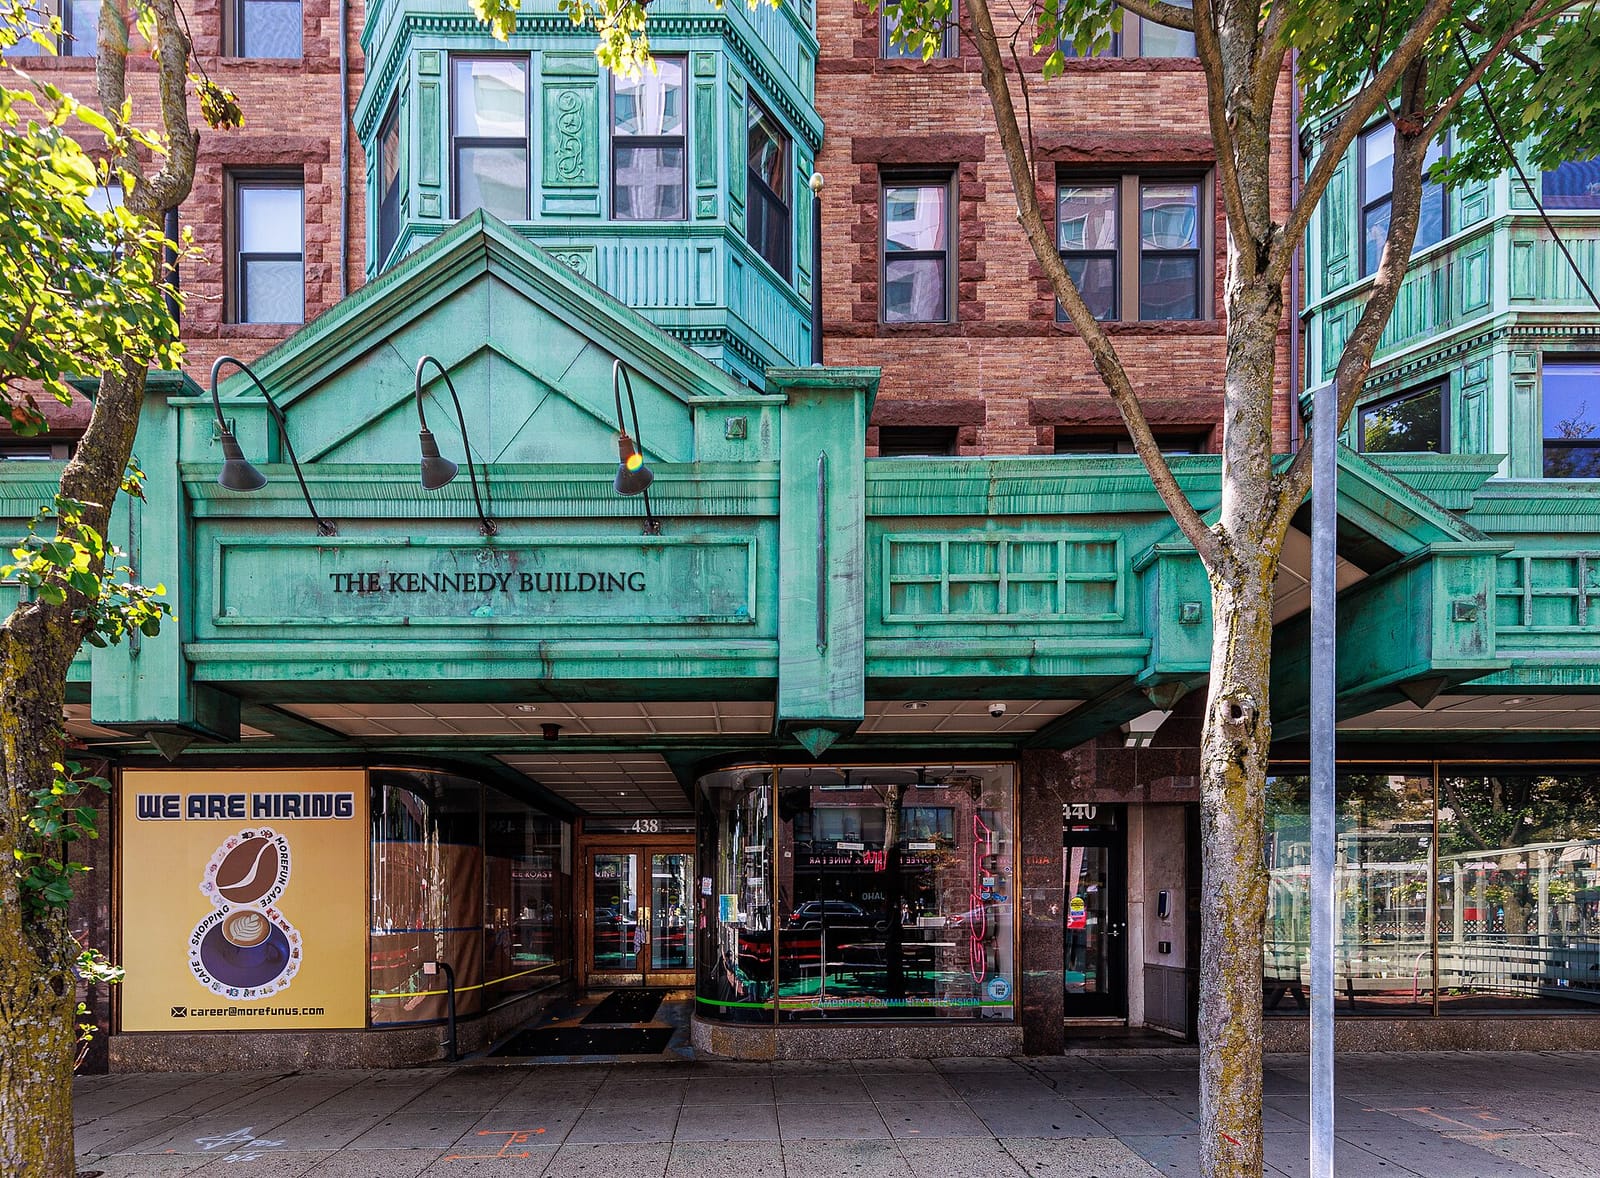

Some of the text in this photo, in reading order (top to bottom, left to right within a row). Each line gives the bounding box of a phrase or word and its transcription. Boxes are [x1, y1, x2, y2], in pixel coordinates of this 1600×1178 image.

[329, 571, 647, 593] THE KENNEDY BUILDING
[137, 793, 353, 819] WE ARE HIRING
[631, 819, 658, 833] 438
[260, 836, 289, 908] MOREFUN CAFE
[191, 904, 230, 946] SHOPPING
[192, 960, 211, 984] CAFE
[190, 1006, 325, 1017] career@morefunus.com
[810, 997, 980, 1008] CAMBRIDGE COMMUNITY TELEVISION
